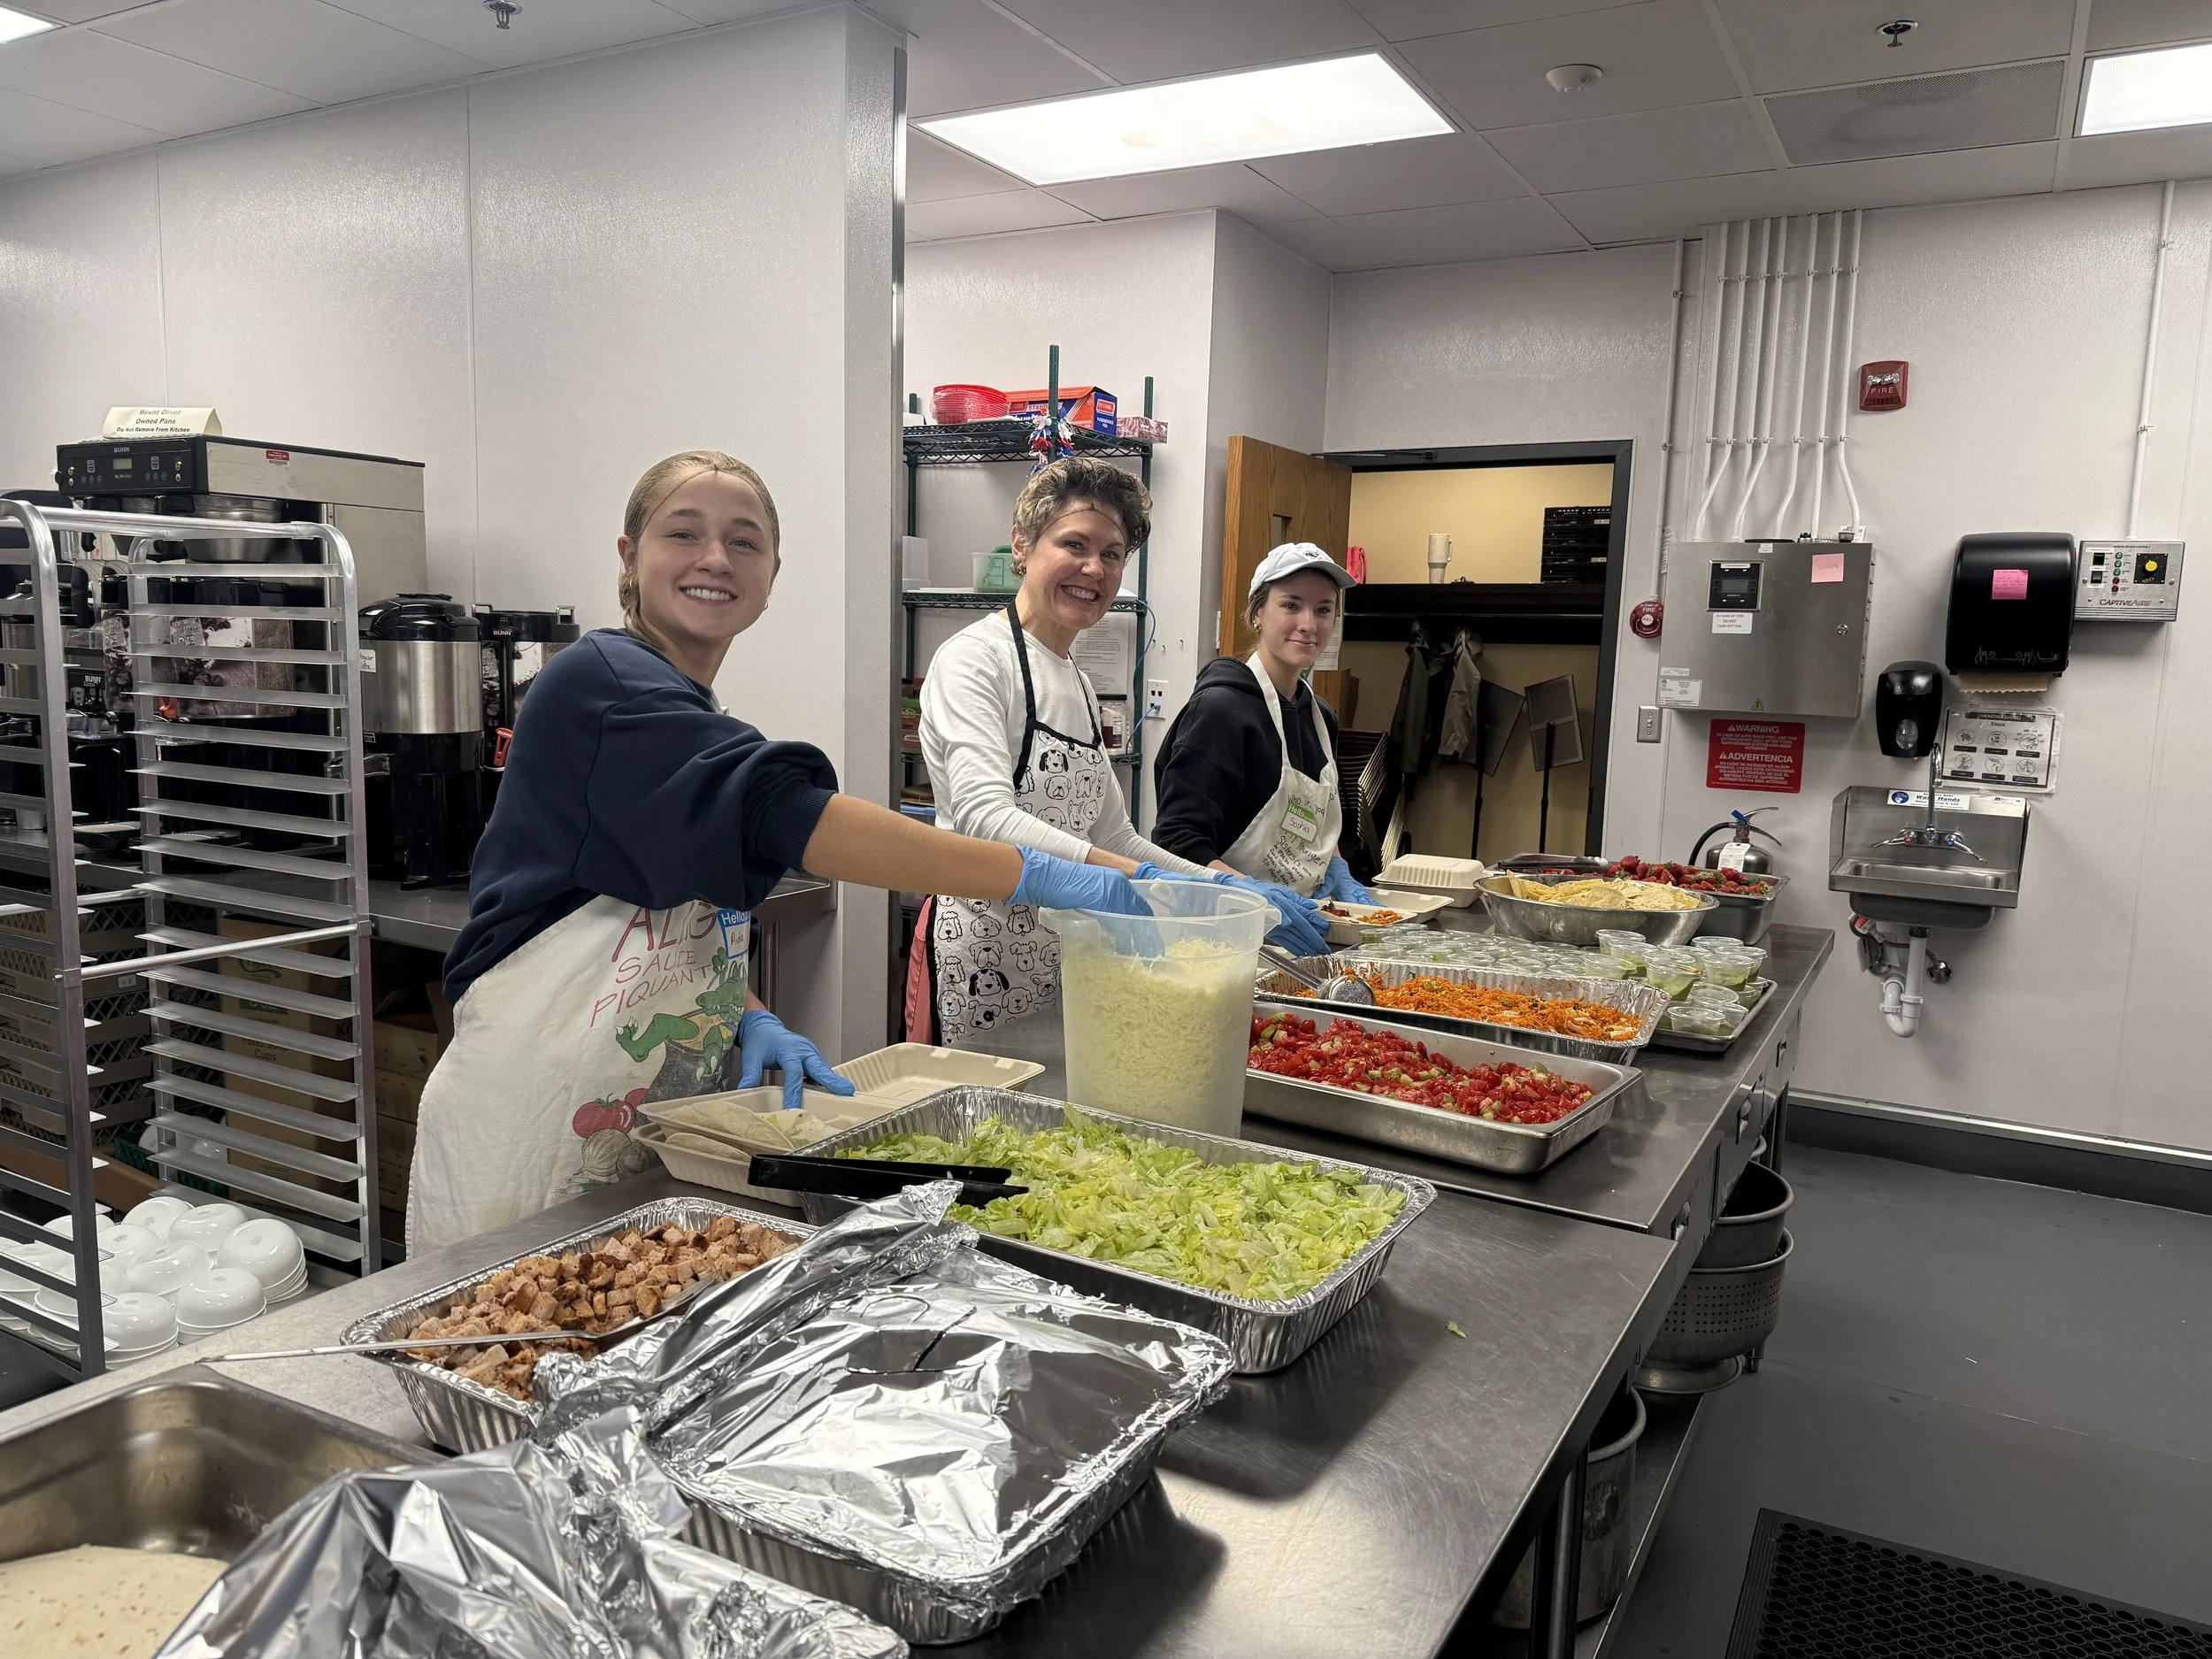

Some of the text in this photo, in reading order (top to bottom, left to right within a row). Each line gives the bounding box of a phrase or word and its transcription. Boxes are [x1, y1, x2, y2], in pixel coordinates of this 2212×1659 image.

[85, 675, 101, 684] BUNN
[1735, 724, 1779, 733] WARNING
[1727, 752, 1793, 763] ADVERTENCIA
[1288, 803, 1305, 818] Hello
[1277, 835, 1296, 861] Sisters
[1296, 839, 1327, 867] Younger
[721, 910, 745, 926] Hello
[615, 950, 696, 984] SAUCE
[590, 964, 712, 1028] PIQUANT
[255, 1049, 277, 1063] Cups
